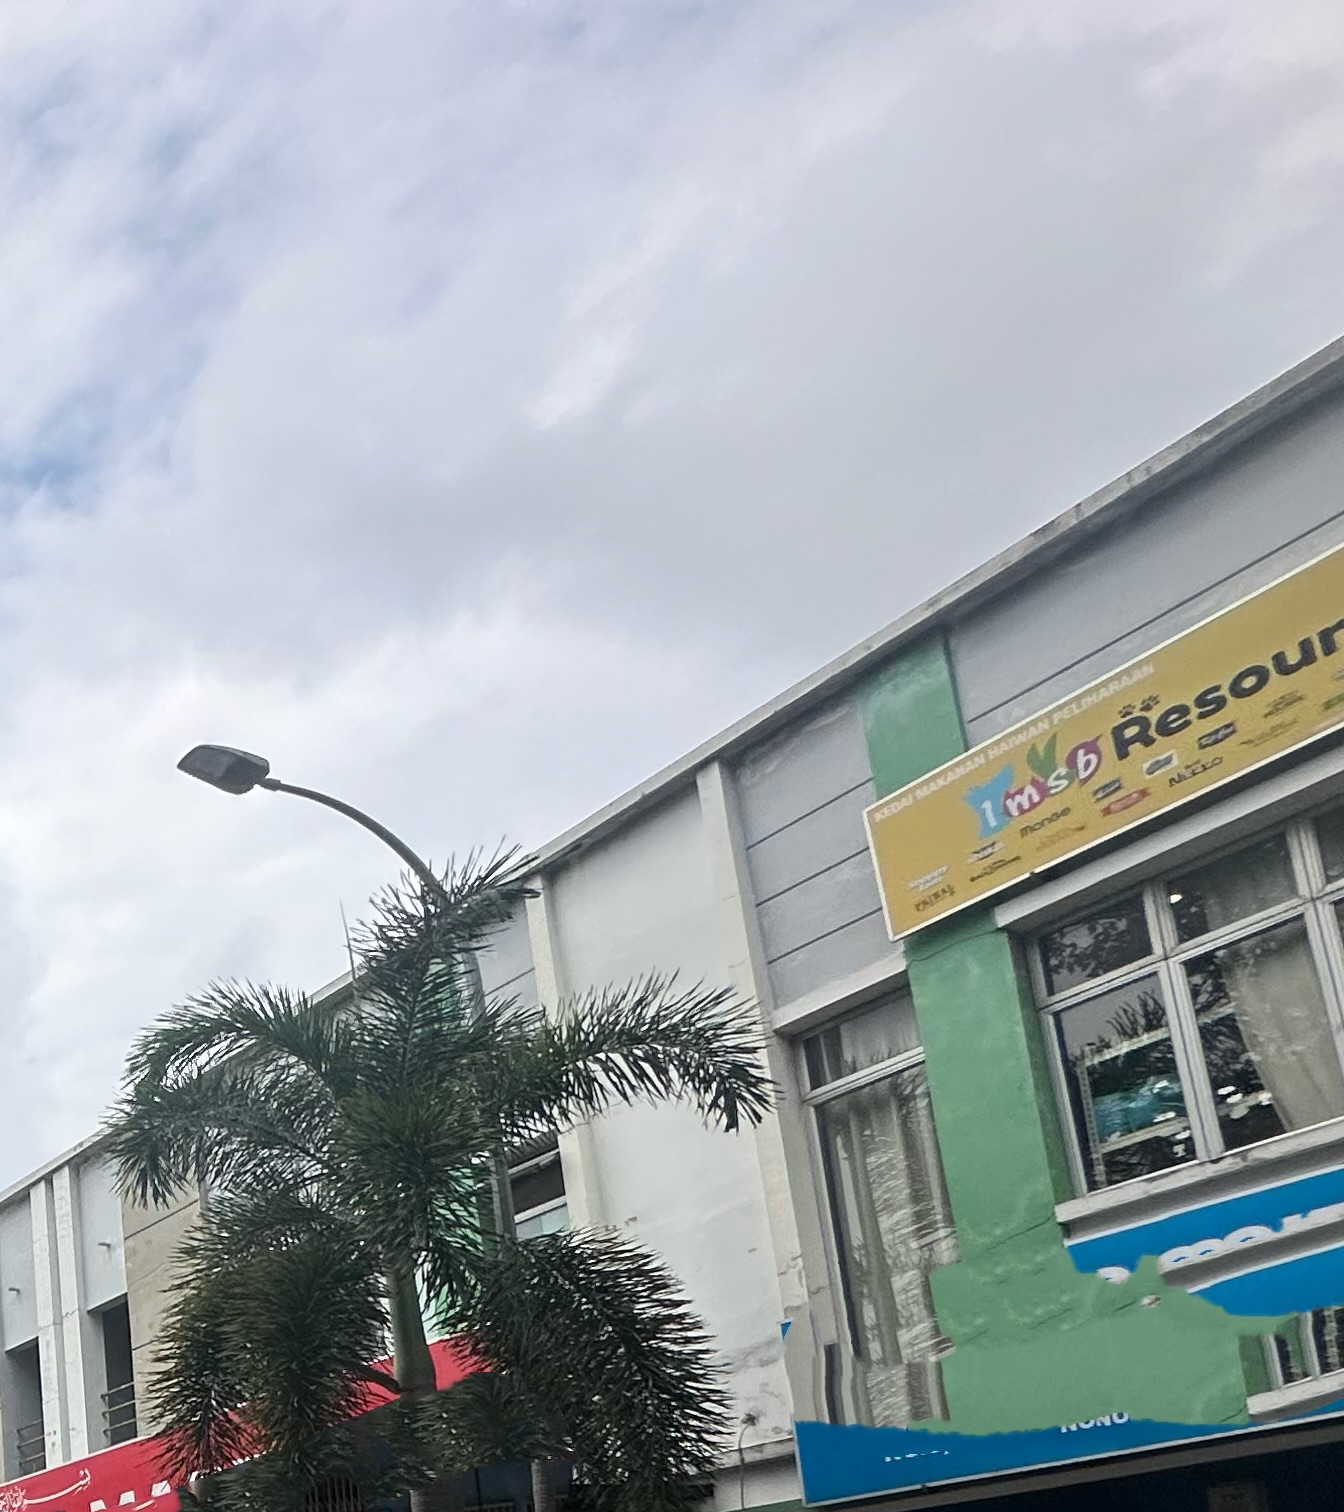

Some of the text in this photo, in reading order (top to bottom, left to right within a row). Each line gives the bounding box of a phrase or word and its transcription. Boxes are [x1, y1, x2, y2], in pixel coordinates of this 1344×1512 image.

[874, 662, 1155, 822] KEDAI MAKANAN HAIWAN PELIHARAAN
